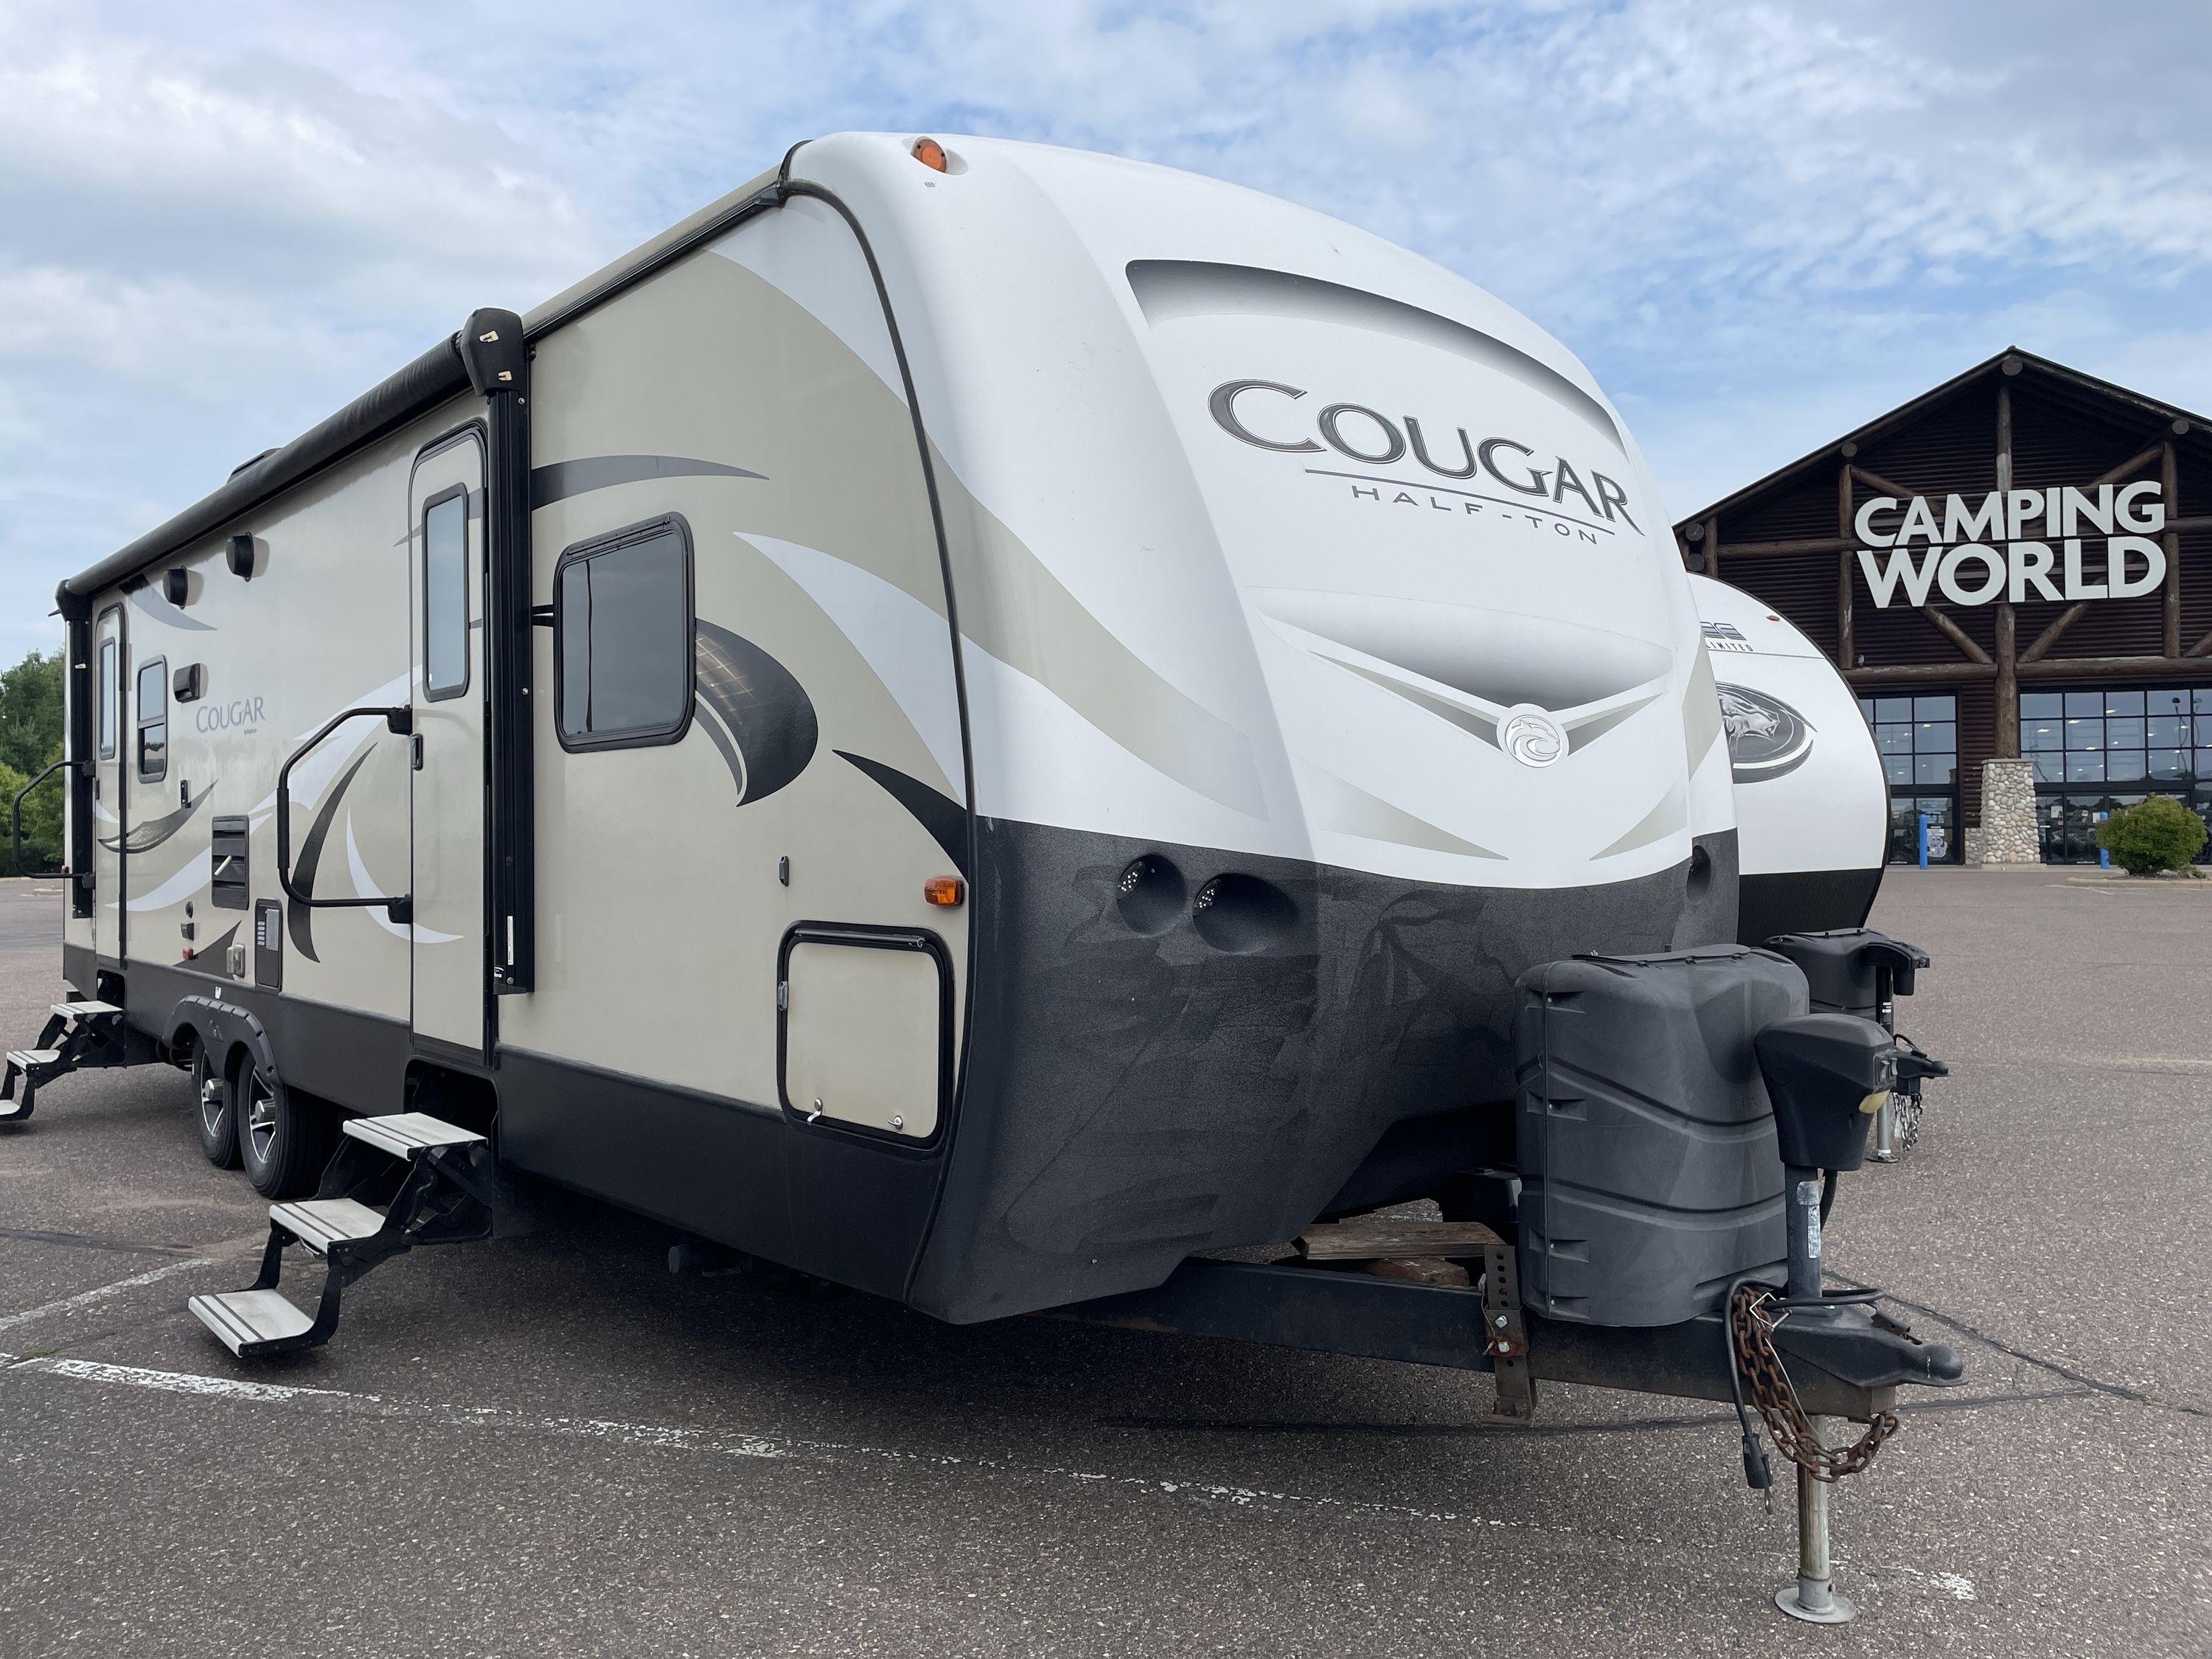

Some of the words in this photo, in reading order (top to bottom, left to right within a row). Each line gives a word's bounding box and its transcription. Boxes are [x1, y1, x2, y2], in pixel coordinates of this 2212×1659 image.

[1207, 378, 1646, 537] COUGAR
[1351, 484, 1598, 545] HALF-TON
[1854, 480, 2166, 548] CAMPING
[1857, 536, 2166, 609] WORLD
[196, 696, 266, 734] COUGAR
